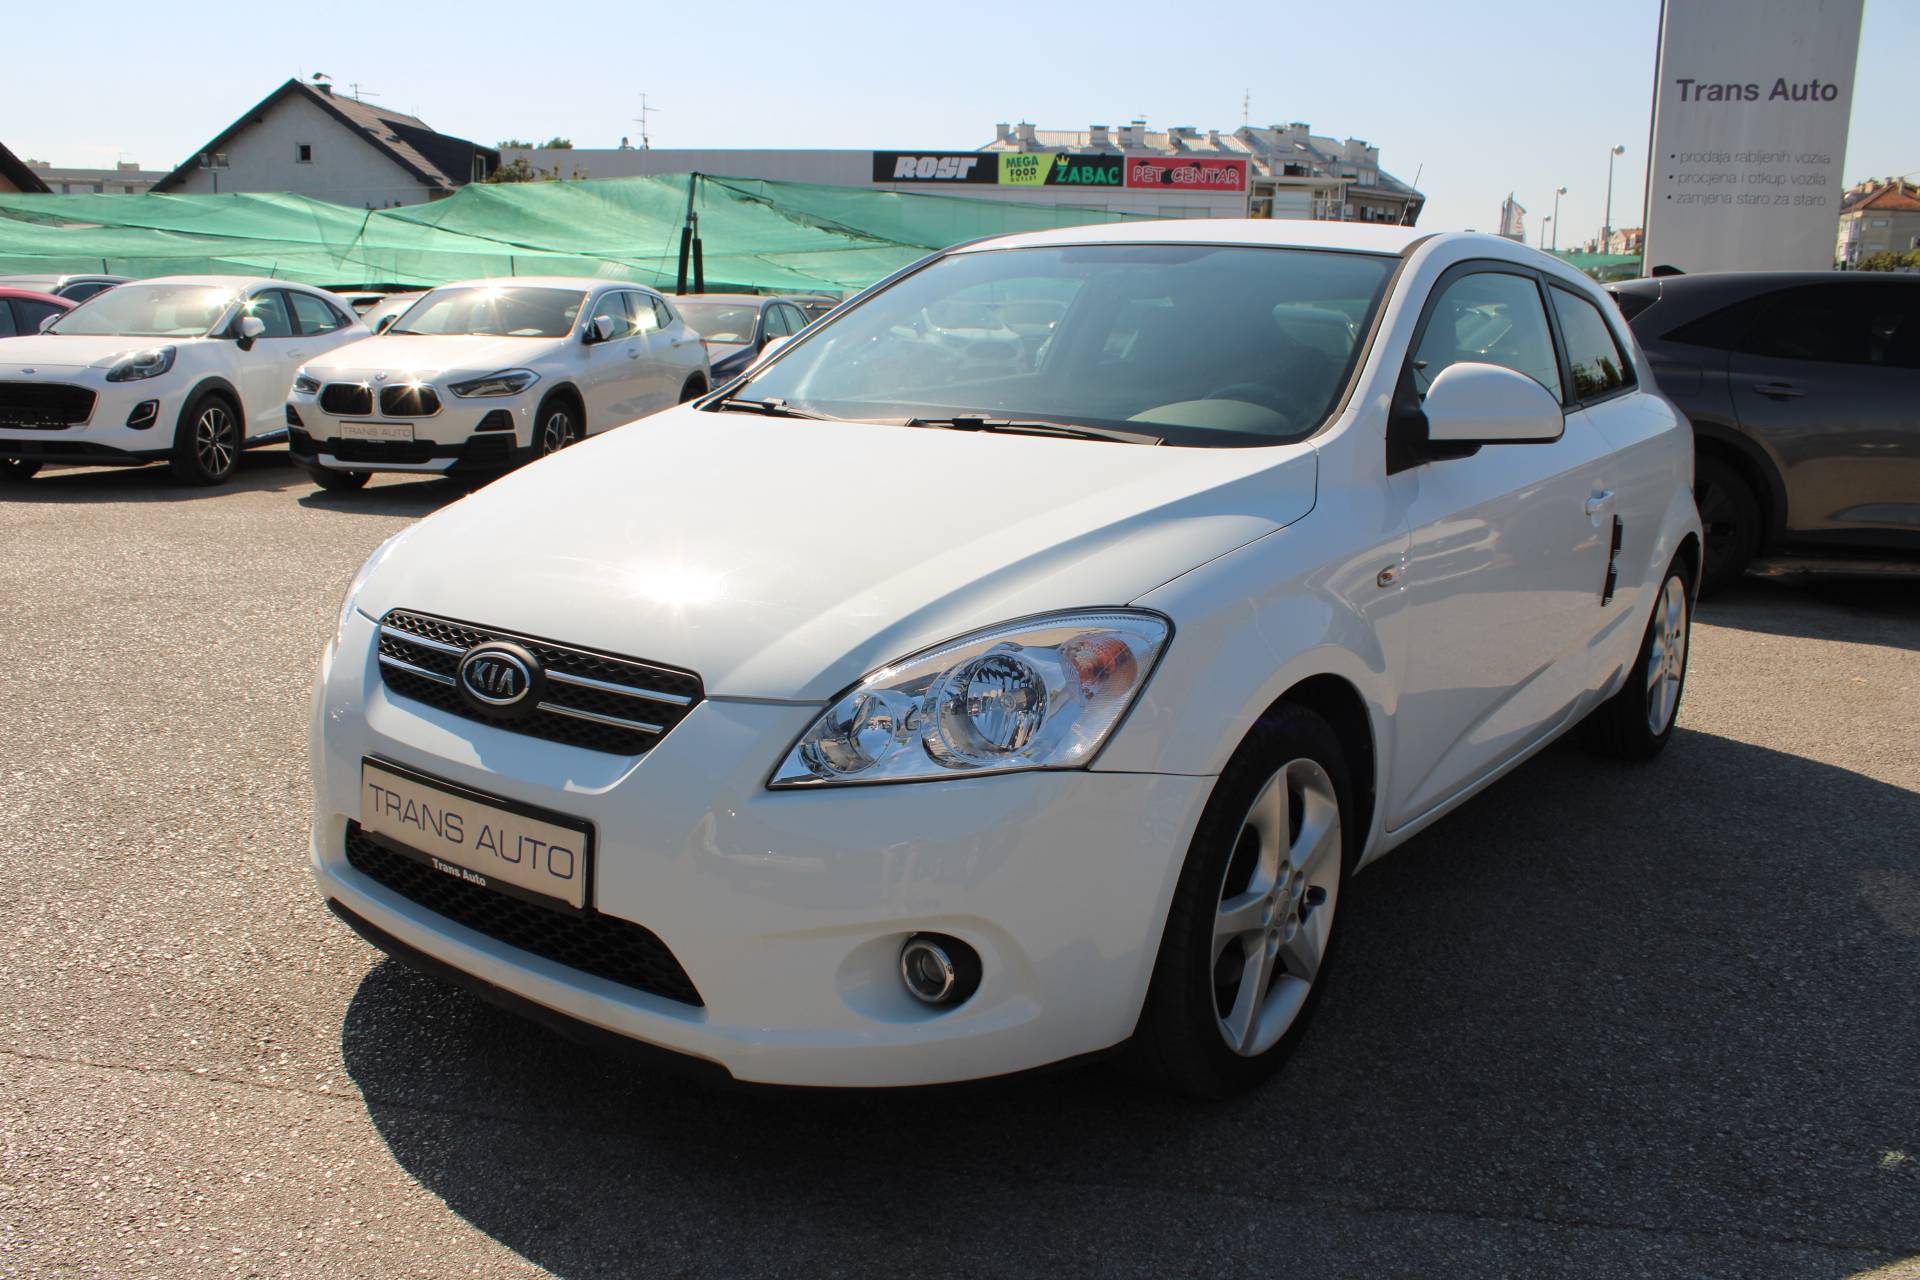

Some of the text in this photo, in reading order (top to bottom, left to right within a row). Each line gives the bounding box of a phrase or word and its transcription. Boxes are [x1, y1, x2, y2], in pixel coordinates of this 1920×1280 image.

[1676, 78, 1839, 101] Trans Auto
[1006, 156, 1039, 168] MEGA
[1010, 168, 1037, 176] FOOD
[1133, 166, 1239, 184] PET CENTAR
[1748, 172, 1786, 186] otkup
[1790, 173, 1826, 185] vozila
[1736, 193, 1770, 205] staro
[1774, 196, 1789, 205] za
[1793, 194, 1826, 206] staro
[471, 660, 515, 696] KIA
[369, 784, 574, 880] TRANS AUTO
[432, 857, 486, 887] Trans Auto
